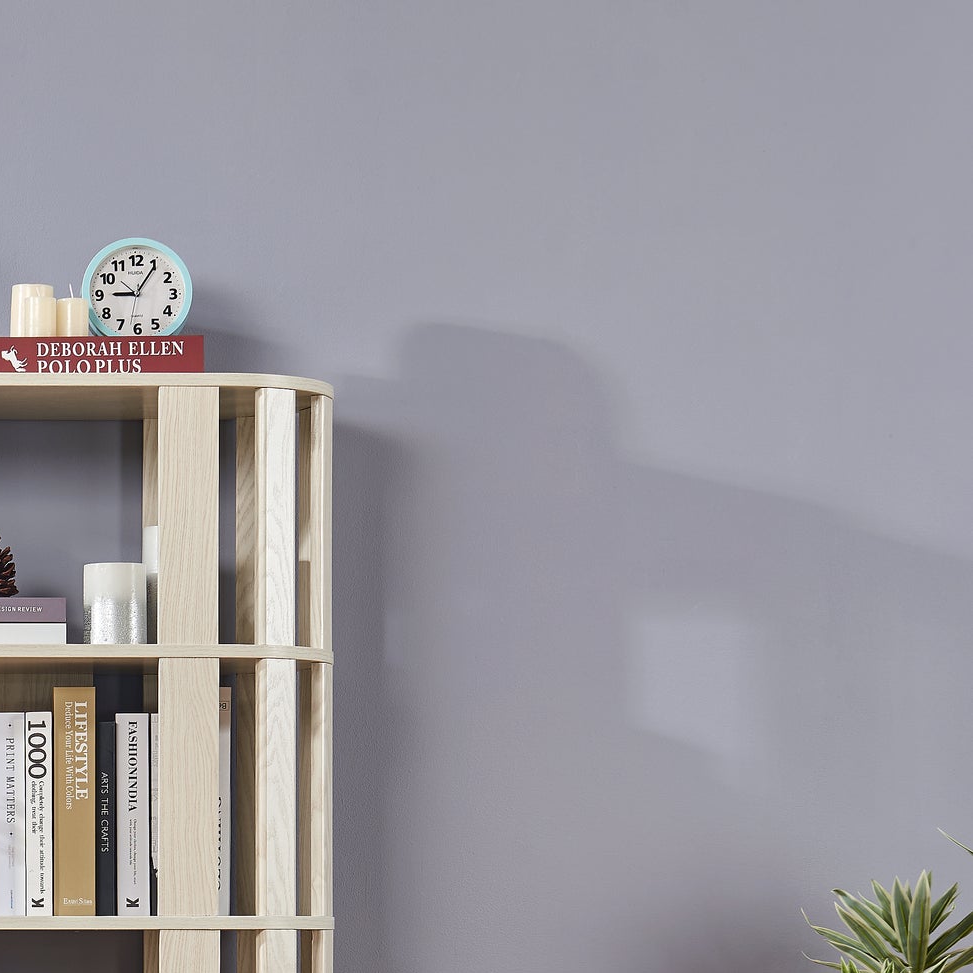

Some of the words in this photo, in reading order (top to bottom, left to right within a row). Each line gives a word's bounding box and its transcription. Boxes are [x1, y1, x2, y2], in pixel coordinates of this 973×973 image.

[111, 259, 125, 272] 11
[128, 254, 144, 267] 12
[150, 259, 156, 270] 1
[100, 272, 116, 285] 10
[163, 272, 172, 284] 2
[94, 289, 104, 302] 9
[169, 288, 178, 300] 3
[102, 307, 111, 320] 8
[162, 304, 173, 317] 4
[116, 318, 125, 330] 7
[133, 323, 142, 335] 6
[151, 318, 160, 330] 5
[36, 342, 121, 358] DEBORAH
[128, 340, 185, 356] ELLEN
[37, 359, 91, 373] POLO
[95, 359, 142, 373] PLUS
[65, 730, 73, 748] Your
[5, 737, 16, 772] PRINT
[27, 720, 48, 780] 1000
[66, 750, 74, 764] Life
[74, 701, 88, 800] LIFESTYLE
[128, 720, 138, 812] FASHIONINDIA
[66, 766, 74, 784] With
[101, 772, 110, 794] ARTS
[6, 776, 16, 824] MATTERS
[37, 780, 45, 812] Completely
[66, 785, 74, 810] Colors
[101, 798, 109, 816] THE
[101, 820, 110, 853] CRAFTS
